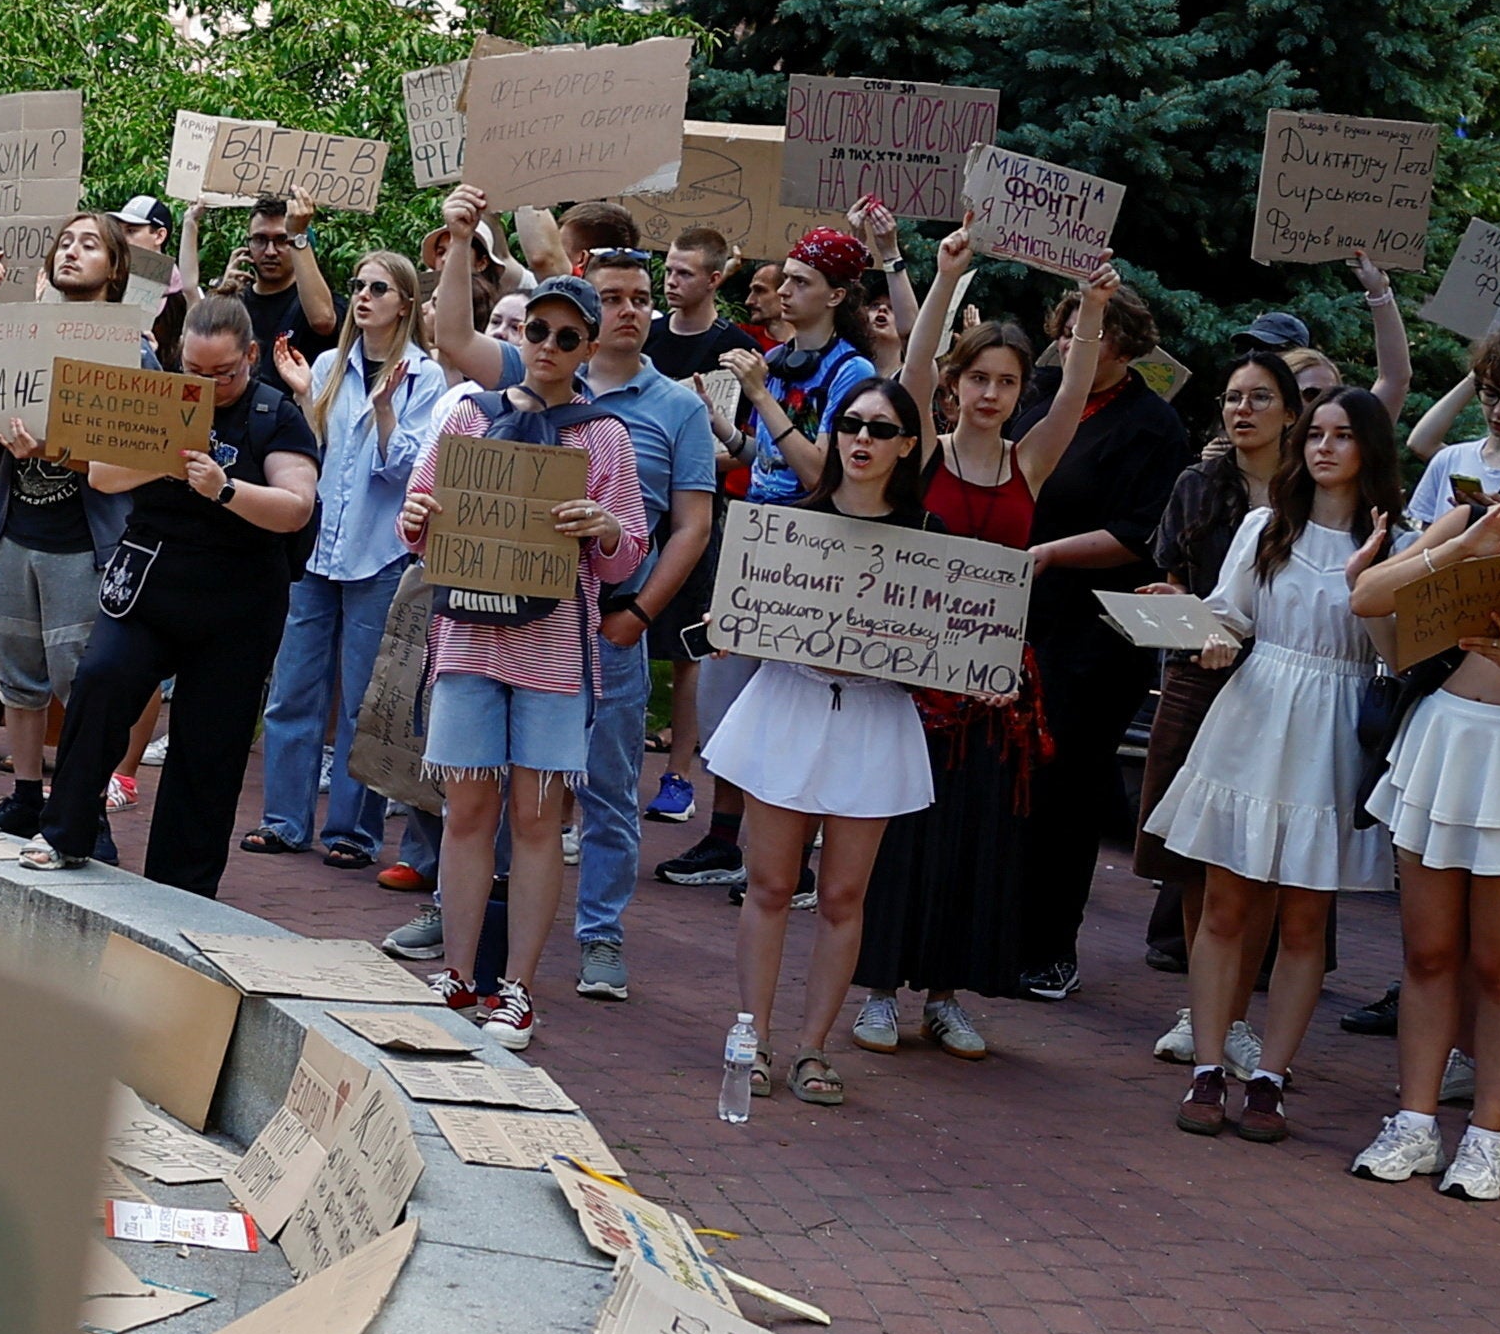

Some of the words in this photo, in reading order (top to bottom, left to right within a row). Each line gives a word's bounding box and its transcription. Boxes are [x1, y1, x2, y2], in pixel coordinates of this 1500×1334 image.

[480, 114, 565, 144] МІНІСТР
[580, 104, 672, 129] ОБОРОНИ
[787, 82, 884, 147] ВІДСТАВКУ
[891, 96, 996, 154] СИРСЬКОГО
[221, 126, 291, 164] БАГ
[297, 133, 344, 171] НЕ
[349, 142, 377, 175] В
[233, 162, 376, 207] ФЕДОРОВІ
[816, 157, 846, 209] НА
[987, 152, 1028, 179] МІЙ
[1035, 167, 1070, 193] ТАТО
[1080, 178, 1104, 203] НА
[1277, 172, 1383, 213] Сирського
[1004, 176, 1088, 221] ФРОНТІ
[978, 197, 993, 224] Я
[1000, 200, 1036, 228] ТУТ
[1047, 214, 1108, 246] ЗЛЮСЯ
[1266, 207, 1335, 255] Федоров
[1337, 234, 1366, 249] наш
[995, 226, 1058, 261] ЗАМІСТЬ
[56, 321, 140, 344] ФЕДОРОВА
[14, 369, 48, 408] НЕ
[62, 364, 173, 398] СИРСЬКИЙ
[59, 389, 159, 416] ФЕДОРОВ
[62, 412, 82, 425] ЦЕ
[87, 416, 103, 427] НЕ
[107, 420, 167, 436] ПРОХАННЯ
[86, 433, 104, 445] ЦЕ
[895, 549, 941, 570] нас
[731, 586, 823, 622] Сирського
[719, 614, 941, 682] ФЕДОРОВА
[966, 660, 1018, 695] МО
